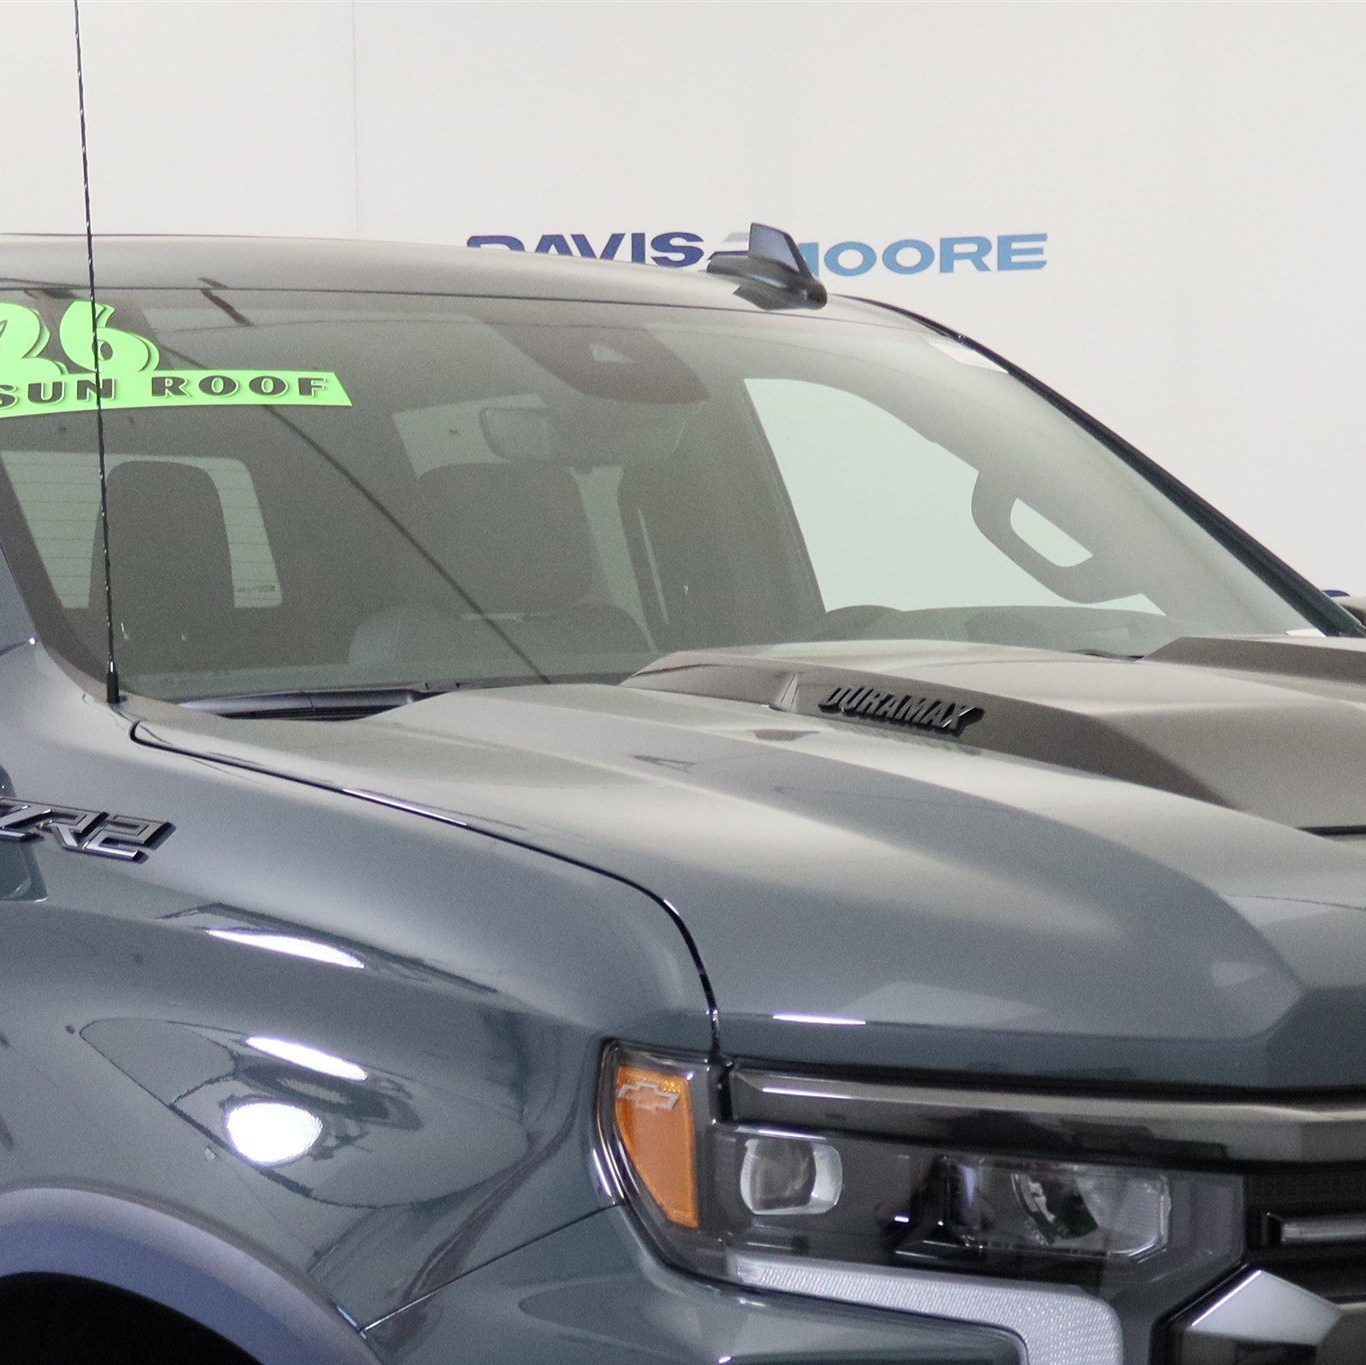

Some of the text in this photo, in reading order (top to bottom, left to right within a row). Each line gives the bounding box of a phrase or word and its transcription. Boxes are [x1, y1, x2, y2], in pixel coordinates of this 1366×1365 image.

[797, 234, 1048, 277] OORE
[151, 374, 330, 399] ROOF
[818, 687, 985, 738] DURAMAX
